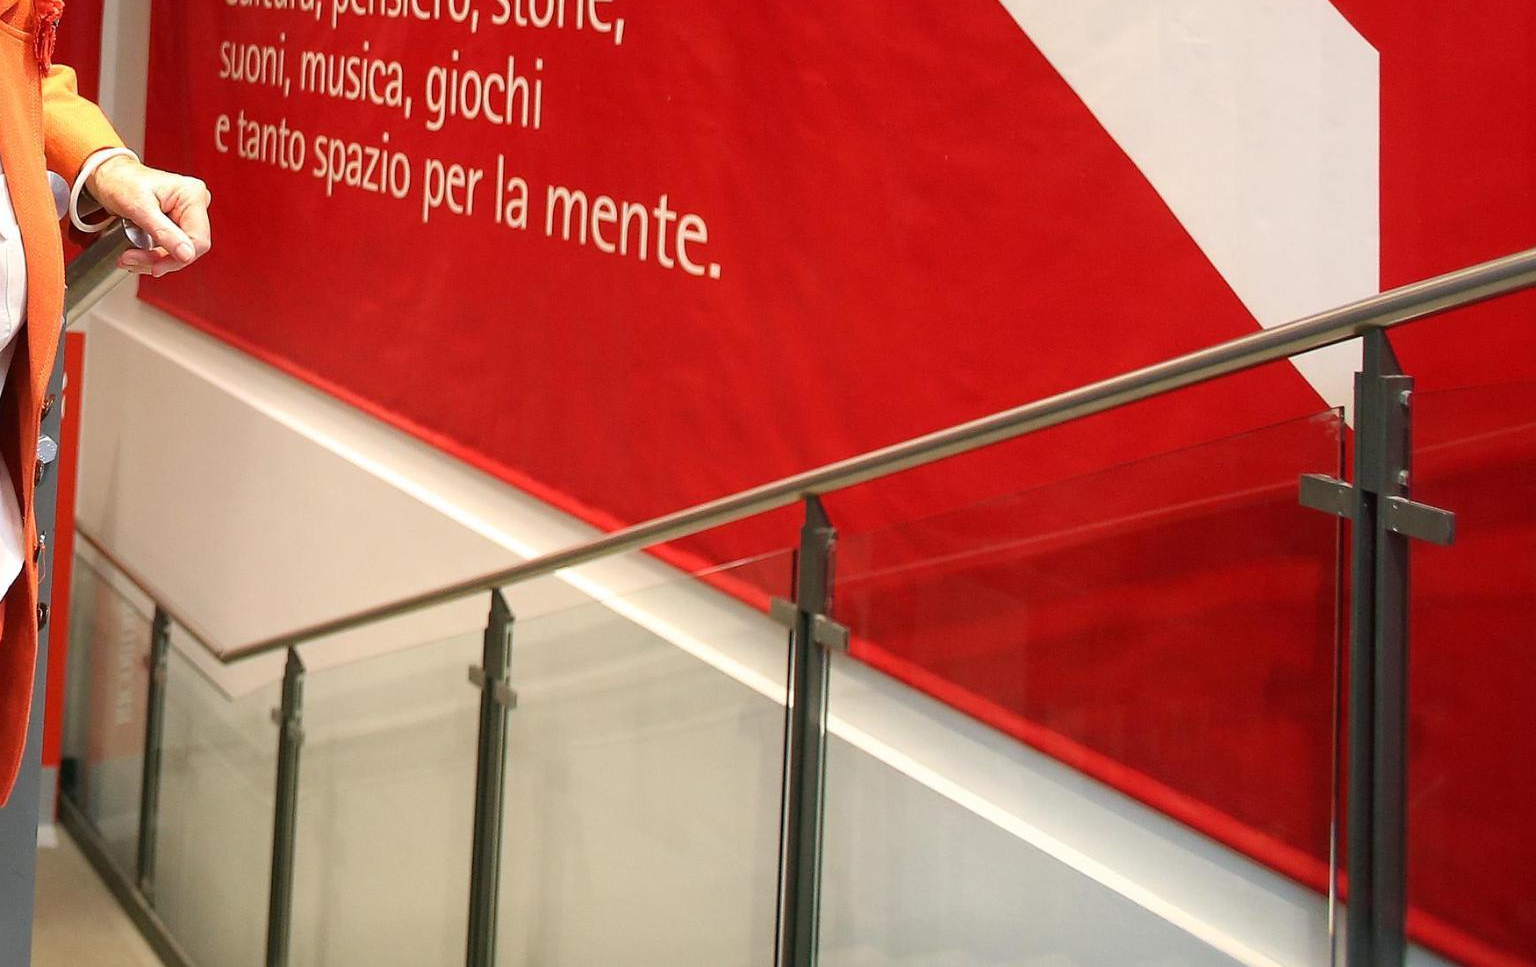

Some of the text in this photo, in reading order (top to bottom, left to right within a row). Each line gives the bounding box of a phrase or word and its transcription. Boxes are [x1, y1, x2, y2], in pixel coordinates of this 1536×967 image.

[219, 32, 544, 132] suoni, musica, giochi
[214, 109, 722, 280] e tanto spazio per la mente.
